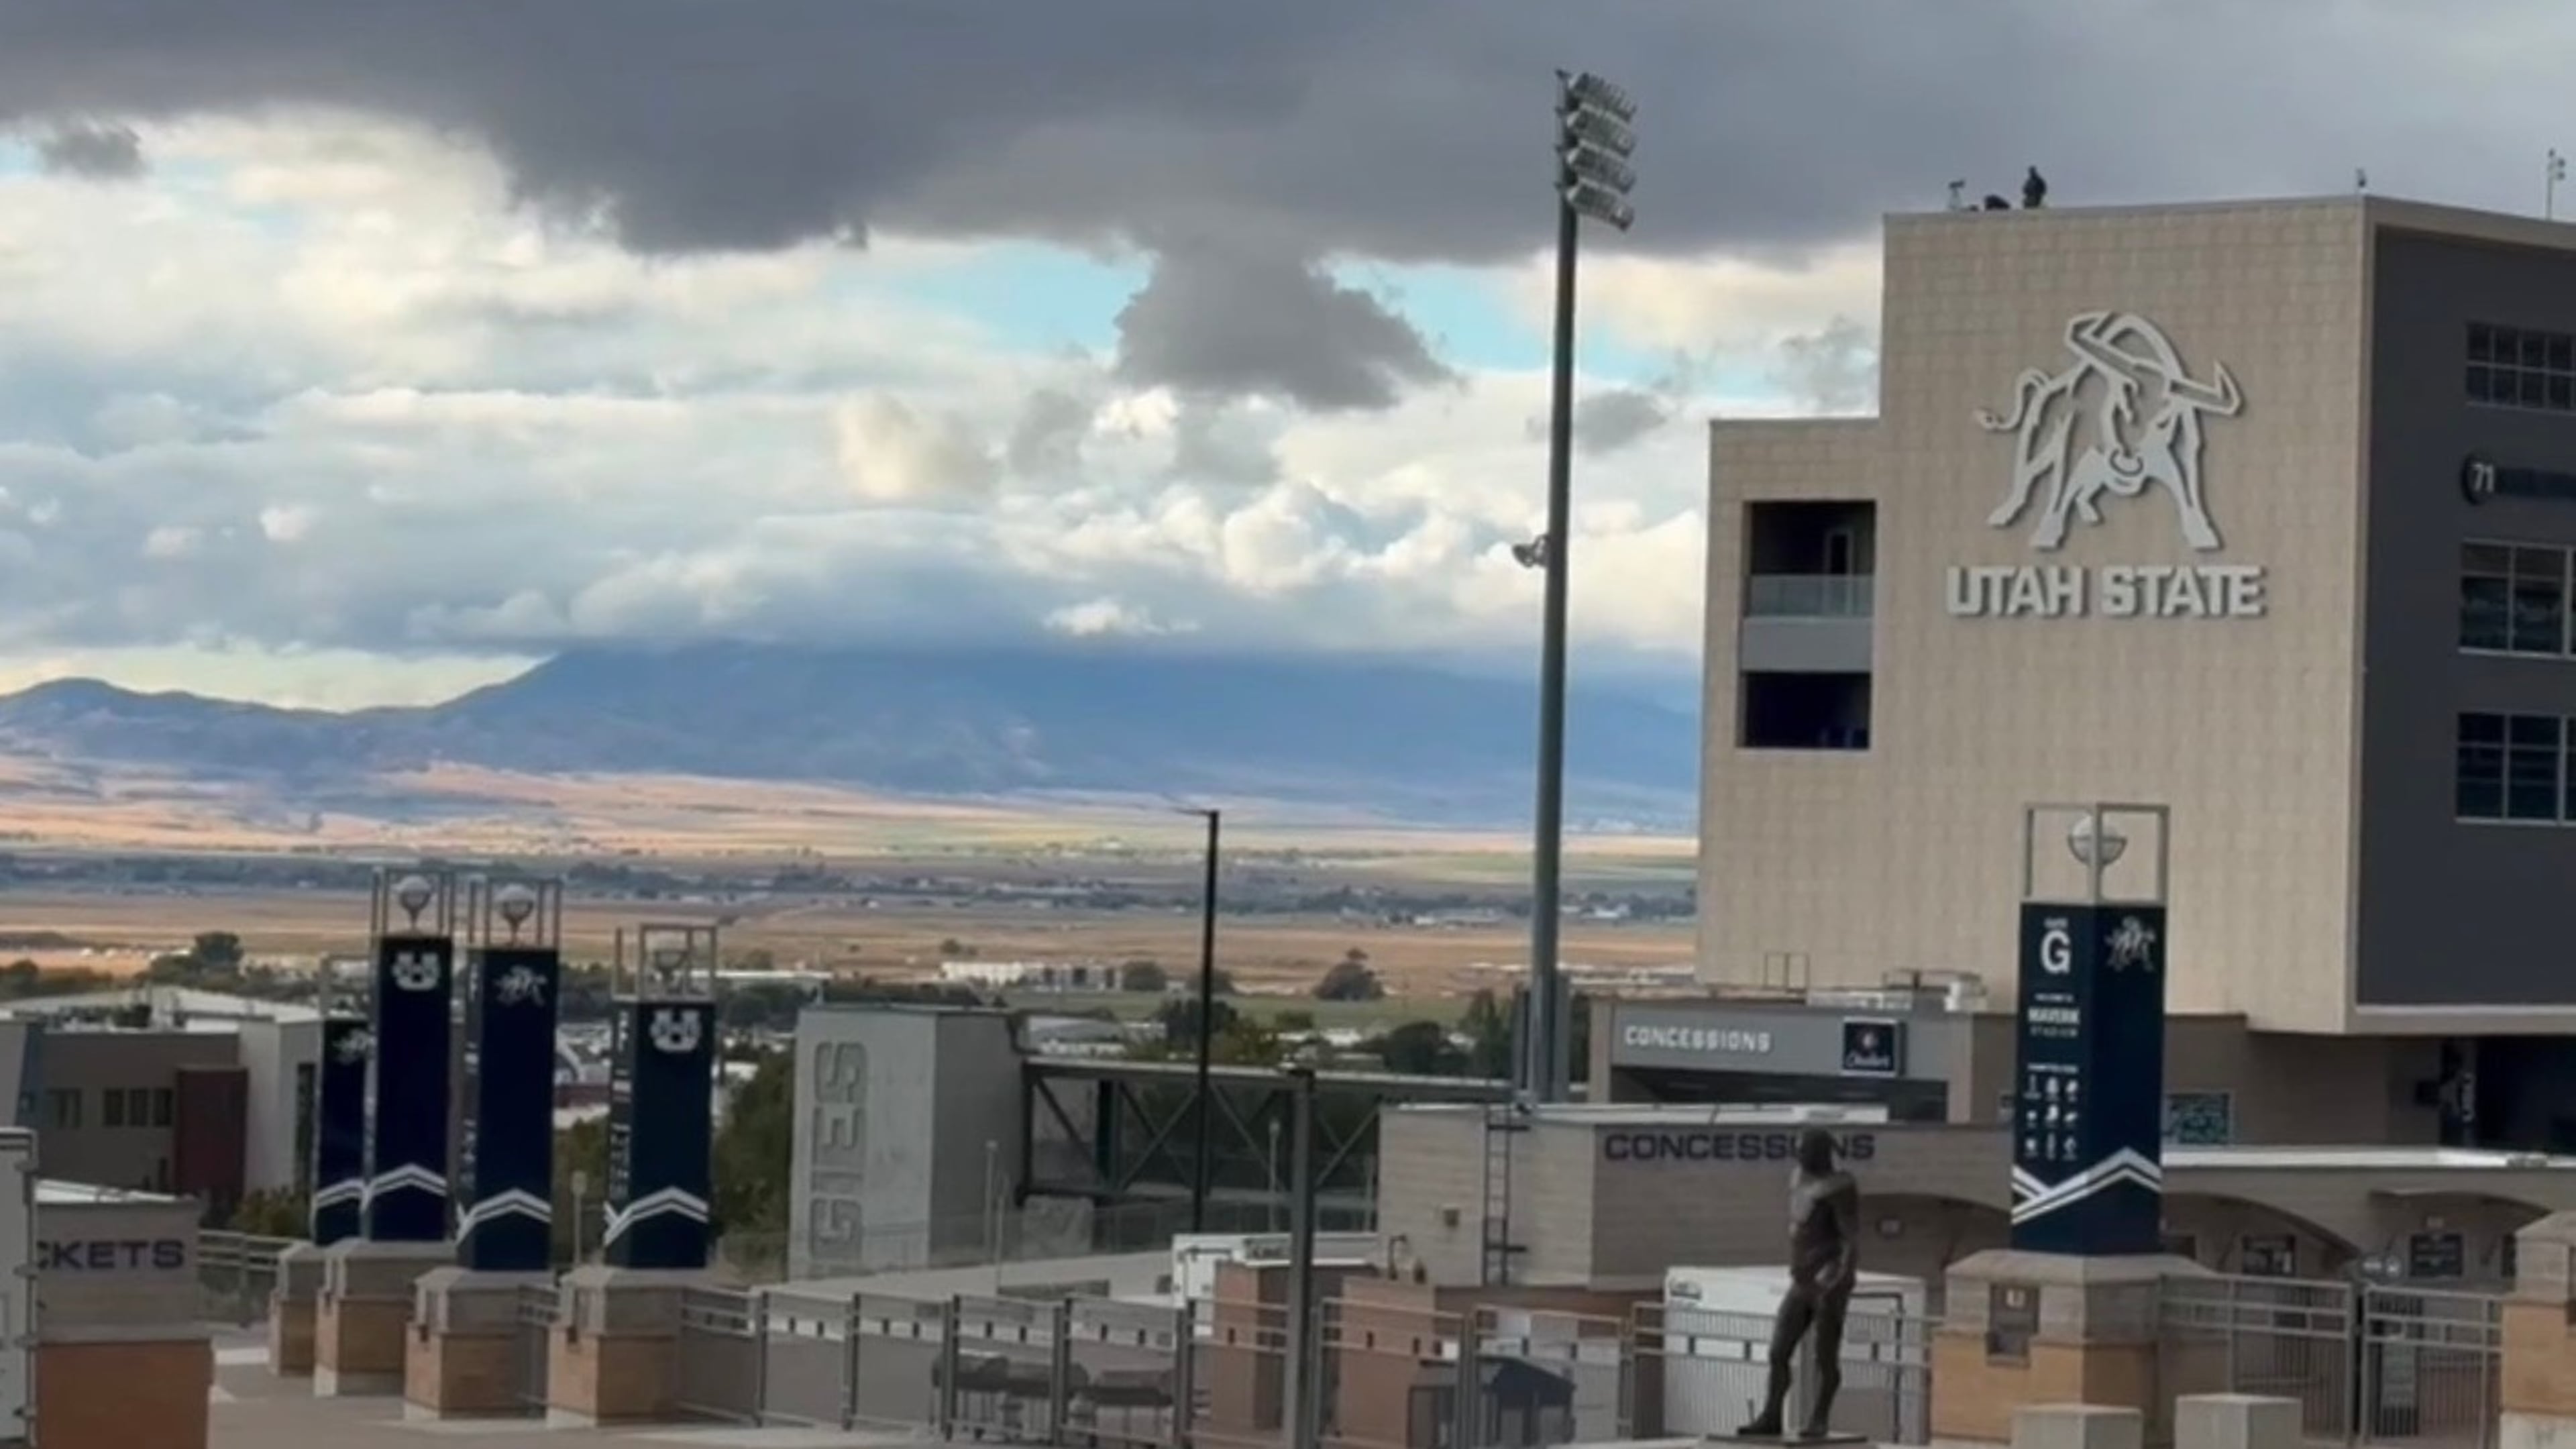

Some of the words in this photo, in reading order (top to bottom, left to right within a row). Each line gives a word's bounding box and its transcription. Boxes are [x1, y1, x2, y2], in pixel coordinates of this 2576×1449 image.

[2471, 462, 2495, 493] 71
[1947, 566, 2086, 616] UTAH
[2102, 566, 2263, 616] STATE
[2040, 929, 2071, 974] G
[1624, 1025, 1772, 1053] CONCESSIONS
[808, 1040, 869, 1278] GIES
[1604, 1133, 1876, 1161] CONCESSINS
